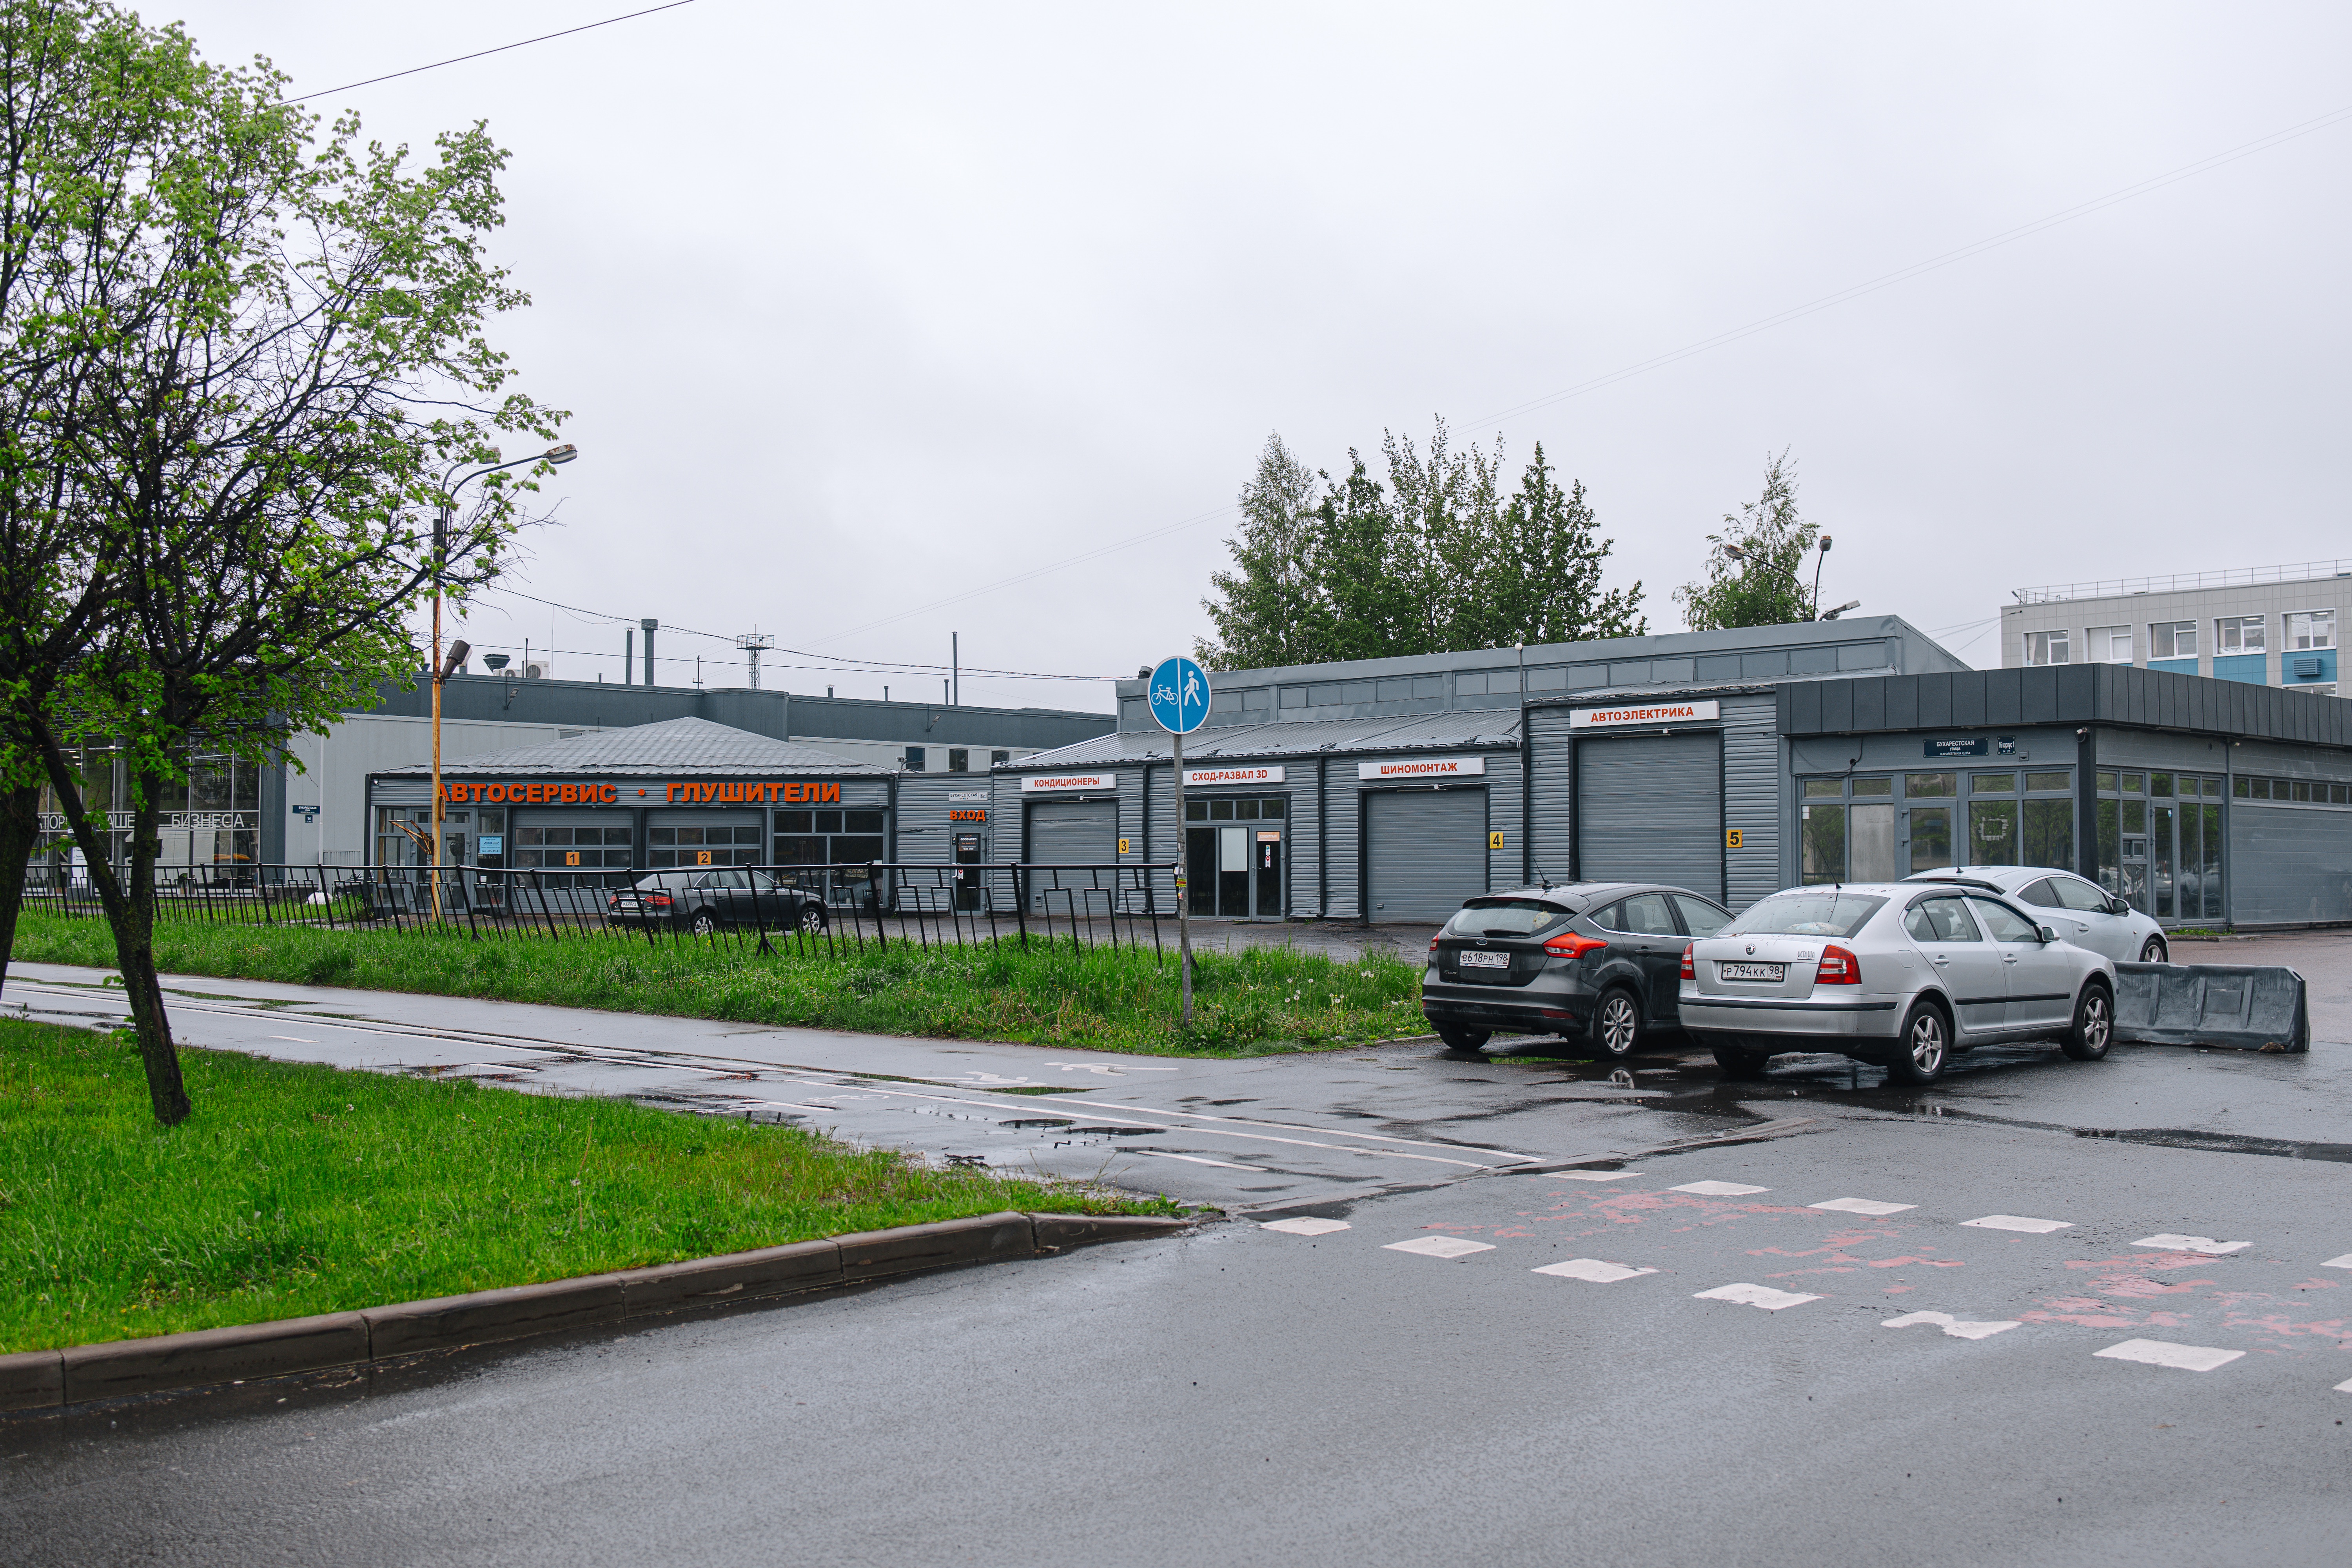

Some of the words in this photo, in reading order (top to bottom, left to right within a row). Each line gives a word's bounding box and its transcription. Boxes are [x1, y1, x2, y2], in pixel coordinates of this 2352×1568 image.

[1591, 707, 1694, 722] АВТОЭЛЕКТРИКА
[1381, 762, 1457, 775] ШИНОМОНТАЖ
[1192, 771, 1254, 782] СХОД-РАЗВАЛ
[1256, 769, 1268, 779] 3D
[1034, 777, 1100, 788] КОНДИЦИОНЕРЫ
[666, 783, 840, 802] ГЛУШИТЕЛИ
[172, 813, 245, 828] БИЗНЕСА
[950, 810, 985, 822] ВХОД
[1493, 834, 1500, 847] 4
[1730, 832, 1739, 845] 5
[1121, 840, 1127, 851] 3
[570, 853, 575, 864] 1
[701, 853, 708, 863] 2
[1463, 953, 1493, 963] В618РН
[1726, 965, 1766, 977] Р794КК
[1769, 965, 1779, 975] 98
